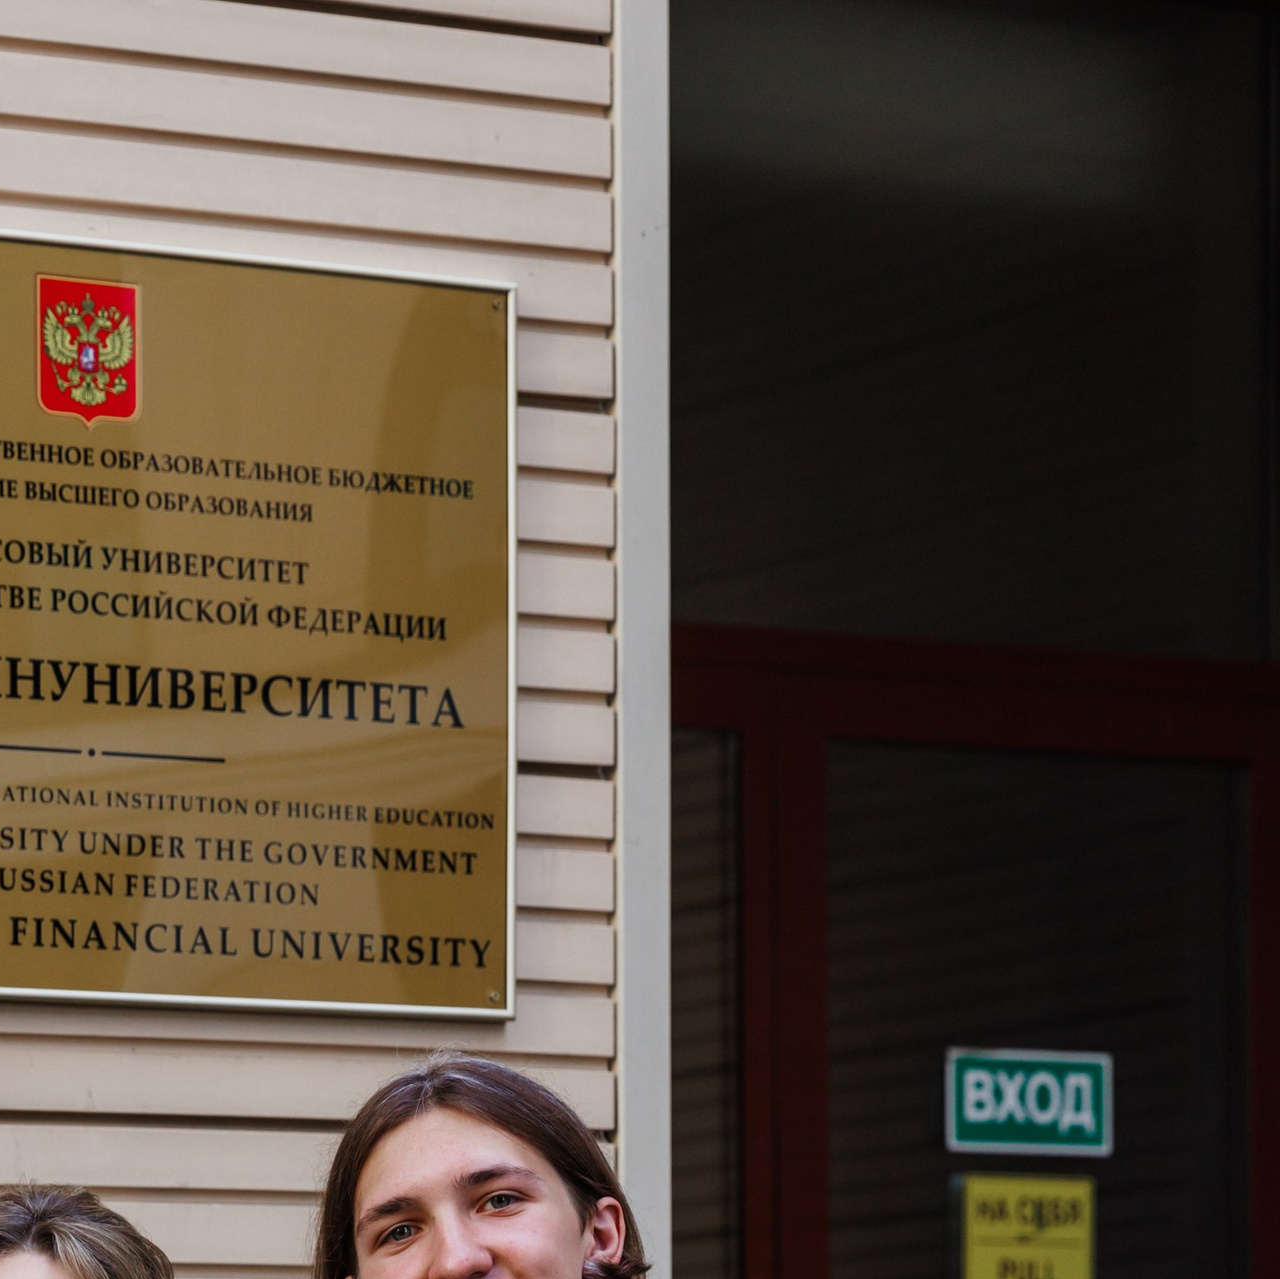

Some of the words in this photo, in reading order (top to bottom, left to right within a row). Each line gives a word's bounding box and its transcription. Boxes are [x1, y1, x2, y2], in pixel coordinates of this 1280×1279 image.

[100, 449, 322, 485] ОБРАЗОВАТЕЛЬНОЕ
[329, 468, 473, 499] БЮДЖЕТНОЕ
[25, 481, 139, 509] ВЫСШЕГО
[146, 491, 312, 523] ОБРАЗОВАНИЯ
[101, 547, 309, 585] УНИВЕРСИТЕТ
[51, 588, 258, 627] РОССИЙСКОЙ
[267, 605, 446, 643] ФЕДЕРАЦИИ
[107, 791, 247, 814] INSTITUTION
[255, 800, 280, 816] OF
[288, 802, 367, 821] HIGHER
[375, 807, 493, 829] EDUCATION
[78, 831, 185, 859] UNDER
[195, 838, 253, 862] THE
[264, 841, 477, 875] GOVERNMENT
[125, 874, 318, 906] FEDERATION
[10, 916, 237, 956] FINANCIAL
[251, 928, 490, 968] UNIVERSITY
[963, 1069, 1095, 1133] ВХОД
